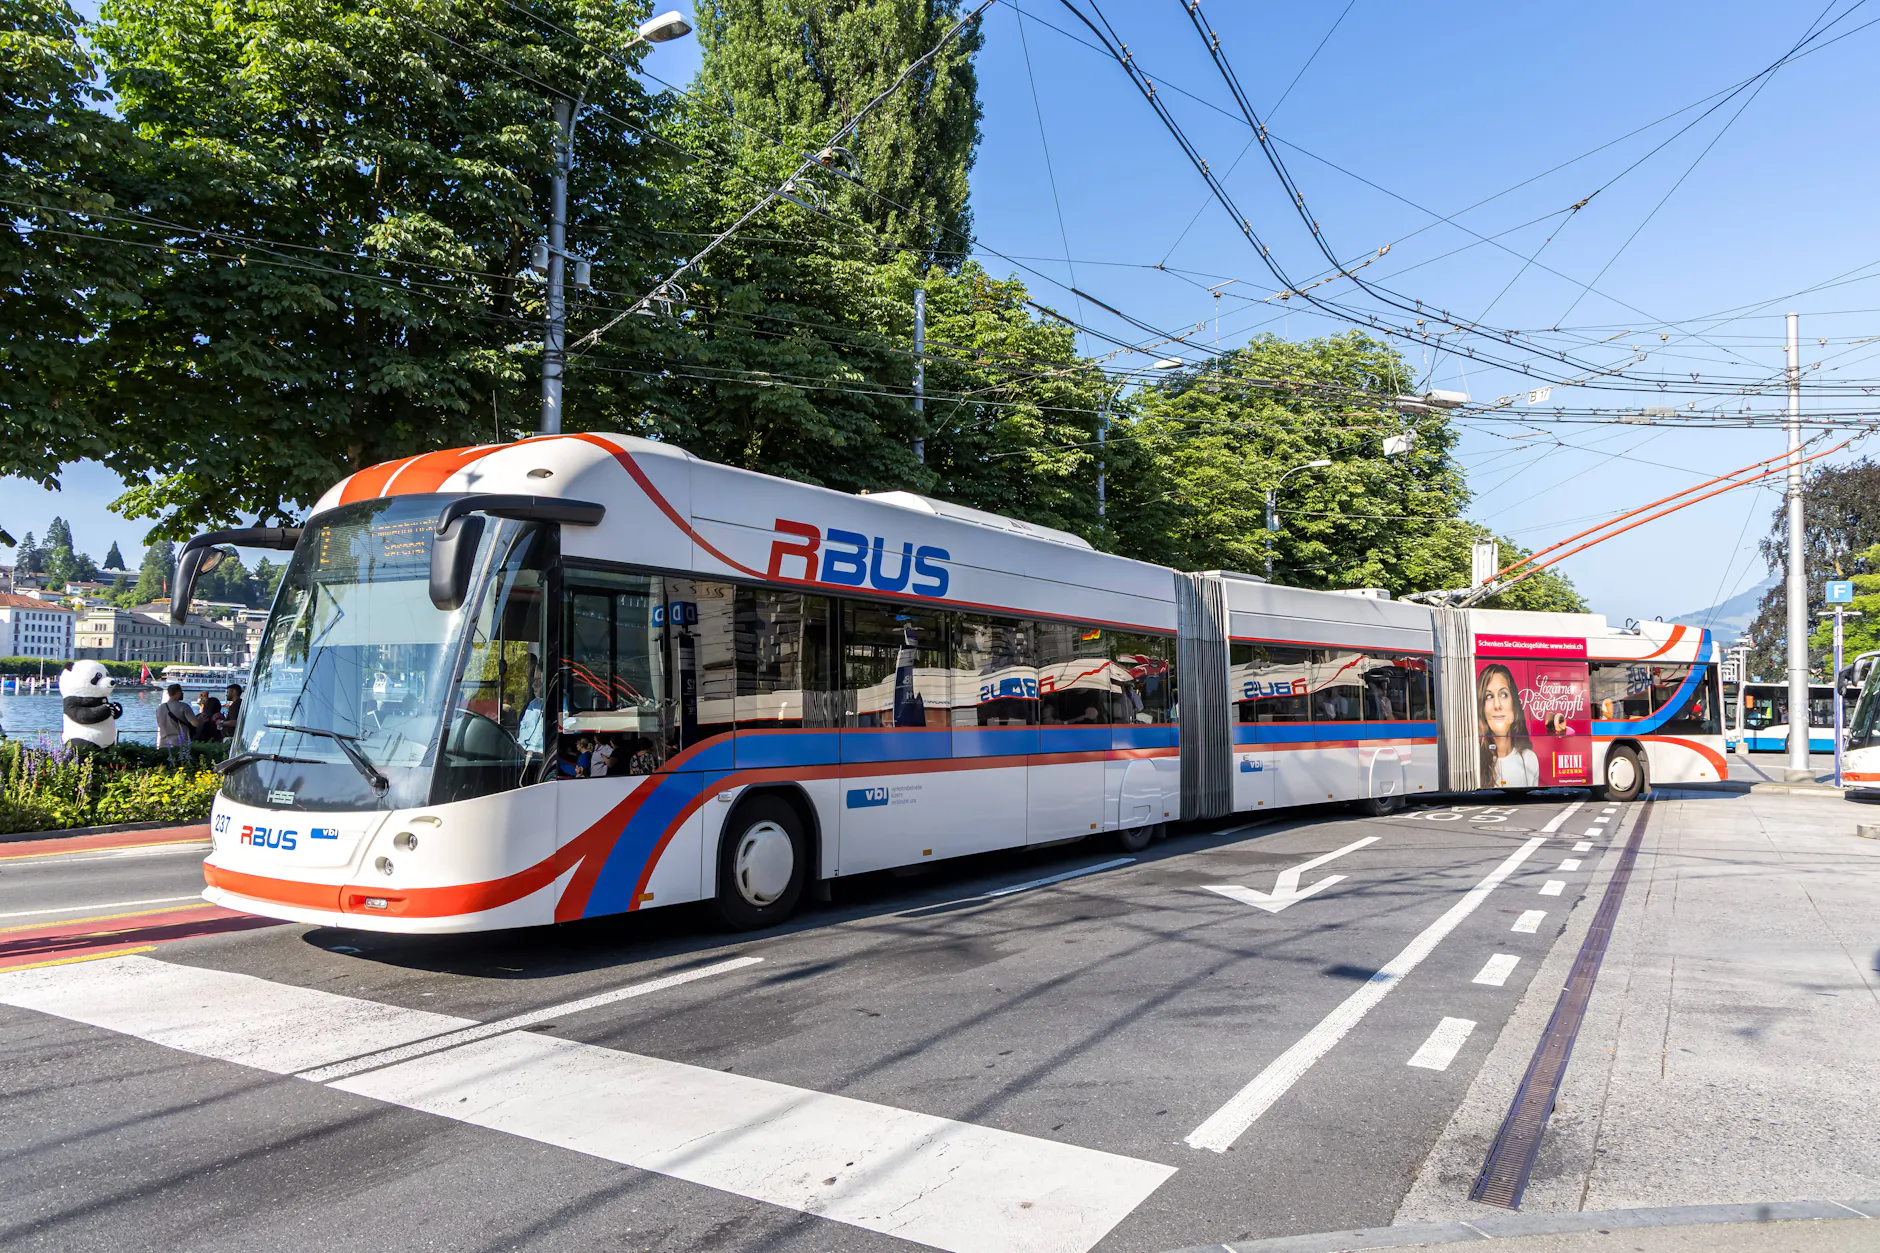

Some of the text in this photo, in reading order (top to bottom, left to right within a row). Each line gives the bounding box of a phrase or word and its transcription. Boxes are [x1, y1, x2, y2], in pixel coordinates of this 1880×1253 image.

[1530, 391, 1537, 402] B
[766, 518, 951, 598] RBUS
[1833, 584, 1847, 599] F
[1478, 639, 1504, 647] Schenken
[1512, 641, 1550, 650] Glücksgefühle:
[1550, 642, 1583, 650] www.heini.ch
[1558, 754, 1582, 768] HEINI
[266, 790, 295, 805] HESS
[865, 787, 887, 800] vbl
[215, 814, 231, 834] 237
[241, 825, 298, 851] RBUS
[322, 828, 339, 837] vbl
